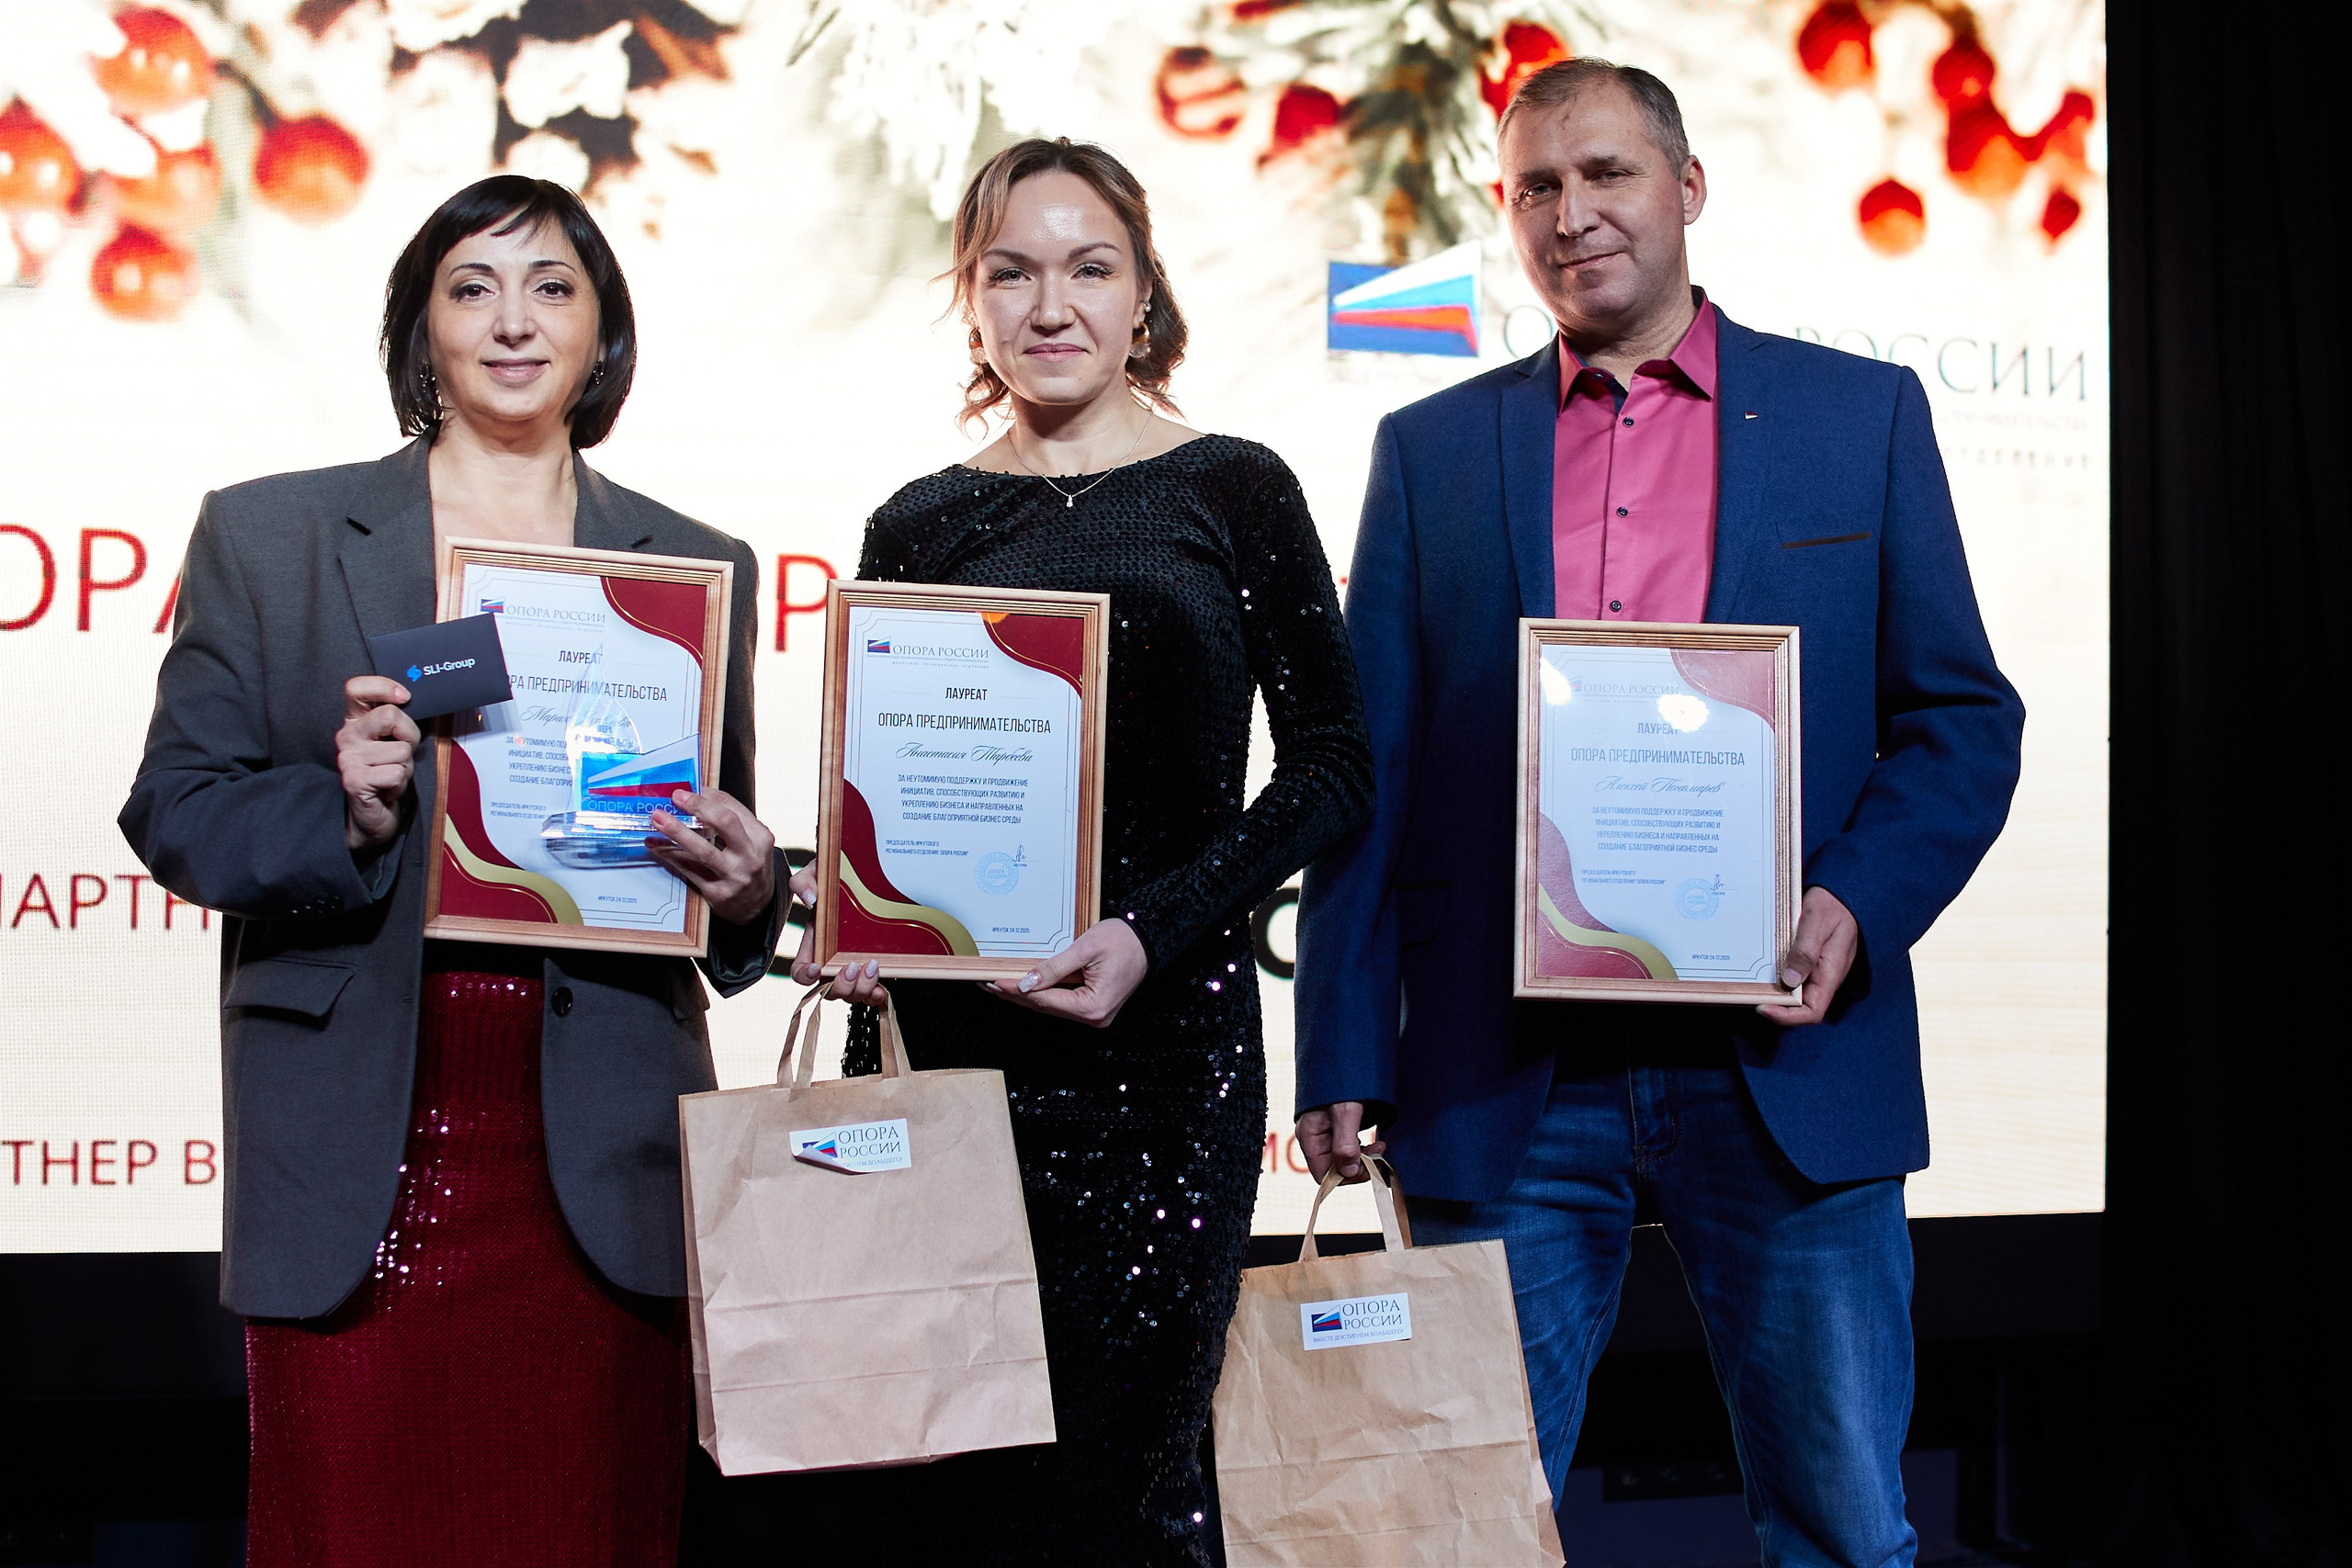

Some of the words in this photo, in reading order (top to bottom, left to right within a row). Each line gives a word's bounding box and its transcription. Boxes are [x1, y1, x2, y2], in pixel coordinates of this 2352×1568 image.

[506, 604, 550, 618] ОПОРА
[553, 609, 606, 624] РОССИИ
[559, 649, 604, 664] ЛАУРЕАТ
[892, 645, 935, 656] ОПОРА
[938, 647, 989, 659] РОССИИ
[423, 658, 476, 676] SLI-Group
[527, 676, 668, 702] ПРЕДПРИНИМАТЕЛЬСТВА
[944, 687, 988, 701] ЛАУРЕАТ
[1583, 682, 1626, 694] ОПОРА
[1628, 684, 1679, 694] РОССИИ
[877, 712, 914, 728] ОПОРА
[916, 713, 1052, 734] ПРЕДПРИНИМАТЕЛЬСТВА
[505, 736, 514, 744] ЗА
[895, 741, 967, 760] Анастасия
[1570, 748, 1606, 762] ОПОРА
[1609, 749, 1746, 766] ПРЕДПРИНИМАТЕЛЬСТВА
[508, 761, 548, 773] УКРЕПЛЕНИЮ
[548, 765, 571, 774] БИЗНЕС
[509, 774, 540, 785] СОЗДАНИЕ
[897, 774, 906, 783] ЗА
[906, 774, 946, 784] НЕУТОМИМУЮ
[946, 776, 982, 785] ПОДДЕРЖКУ
[988, 778, 1029, 787] ПРОДВИЖЕНИЕ
[936, 788, 989, 798] СПОСОБСТВУЮЩИХ
[989, 790, 1020, 799] РАЗВИТИЮ
[588, 799, 634, 813] ОПОРА
[900, 800, 939, 808] УКРЕПЛЕНИЮ
[939, 801, 965, 809] БИЗНЕСА
[970, 802, 1015, 811] НАПРАВЛЕННЫХ
[1600, 807, 1641, 815] НЕУТОМИМУЮ
[1682, 808, 1724, 818] ПРОДВИЖЕНИЕ
[902, 812, 933, 821] СОЗДАНИЕ
[933, 812, 979, 822] БЛАГОПРИЯТНОЙ
[979, 815, 1002, 823] БИЗНЕС
[1001, 816, 1022, 824] СРЕДЫ
[1630, 819, 1684, 829] СПОСОБСТВУЮЩИХ
[1596, 830, 1634, 839] УКРЕПЛЕНИЮ
[1634, 831, 1660, 840] БИЗНЕСА
[1665, 832, 1711, 841] НАПРАВЛЕННЫХ
[1598, 842, 1628, 852] СОЗДАНИЕ
[1628, 842, 1675, 852] БЛАГОПРИЯТНОЙ
[1675, 844, 1698, 852] БИЗНЕС
[1698, 845, 1718, 853] СРЕДЫ
[838, 1125, 899, 1145] ОПОРА
[840, 1141, 901, 1158] РОССИИ
[1, 1139, 158, 1186] ТНЕР
[1342, 1299, 1400, 1316] ОПОРА
[1344, 1314, 1402, 1330] РОССИИ
[1313, 1335, 1334, 1343] ВМЕСТЕ
[1334, 1332, 1370, 1342] ДОСТИГНЕМ
